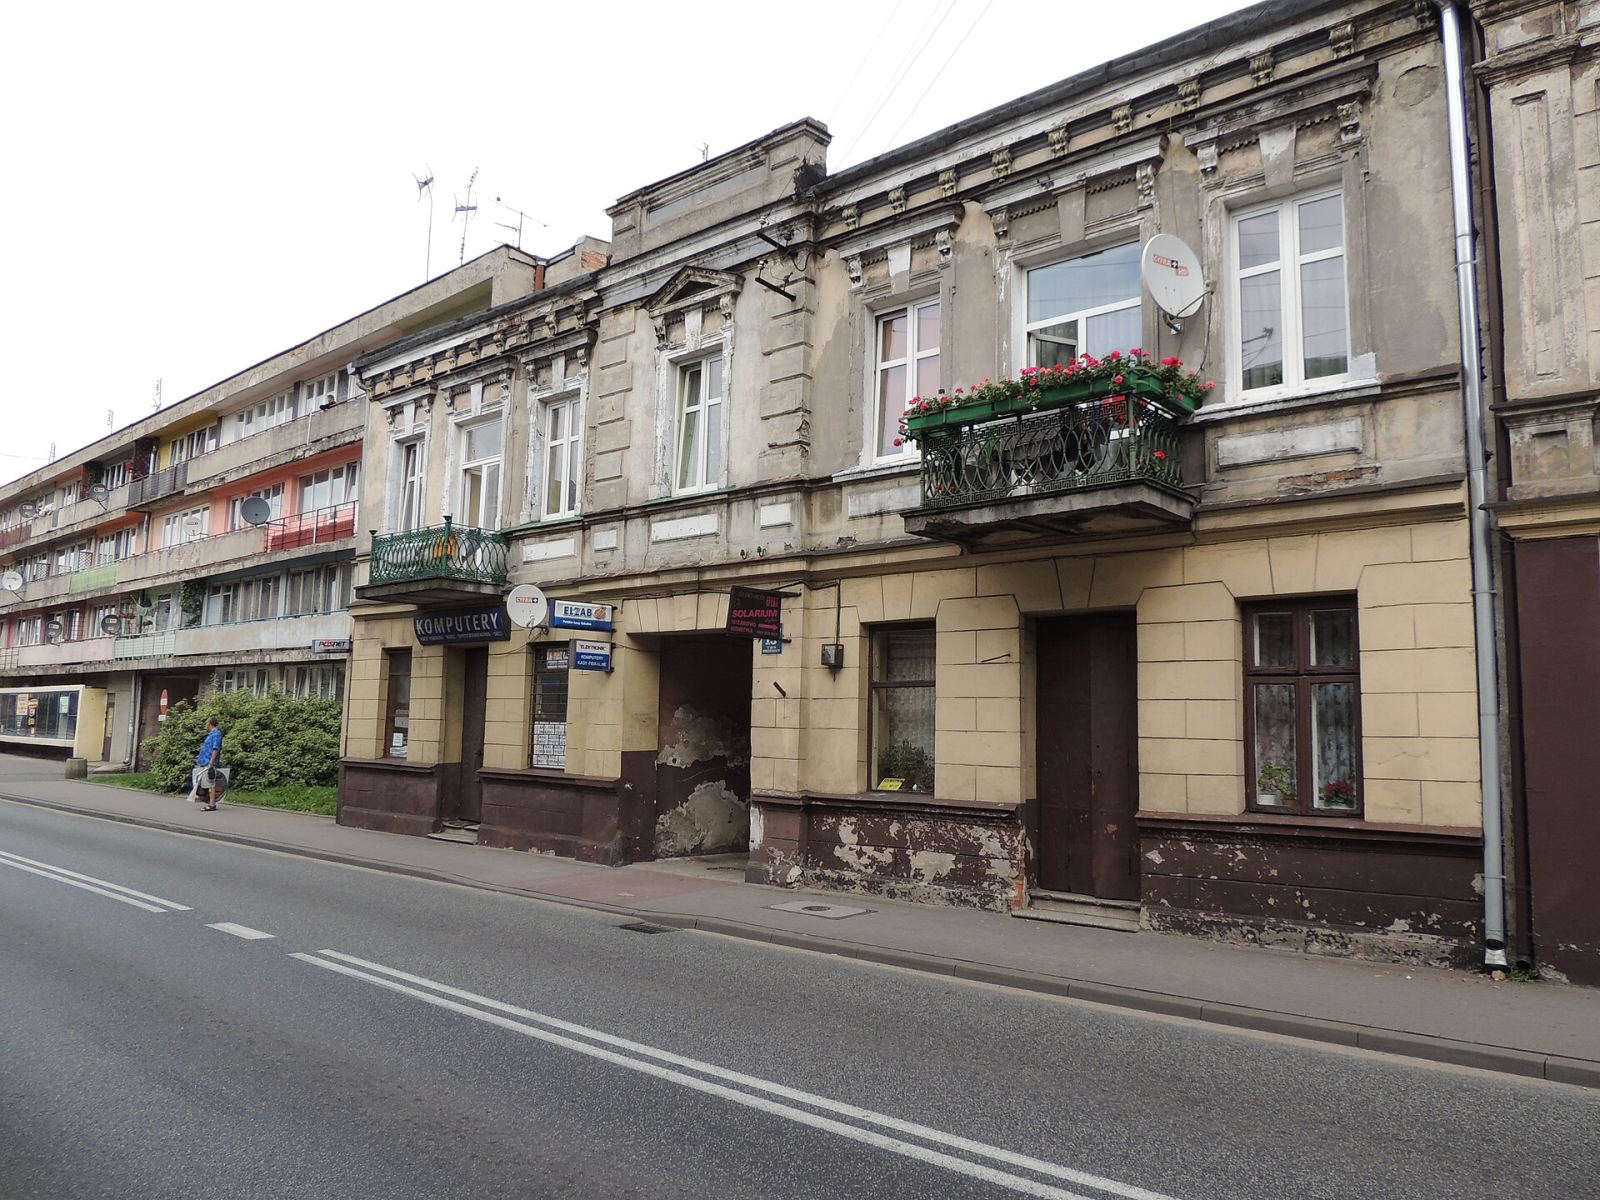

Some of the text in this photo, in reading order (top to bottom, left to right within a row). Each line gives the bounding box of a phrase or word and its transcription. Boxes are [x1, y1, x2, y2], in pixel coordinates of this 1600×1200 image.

[564, 606, 592, 616] ELZAB
[732, 609, 778, 618] SOLARIUM
[416, 613, 498, 634] KOMPUTERY
